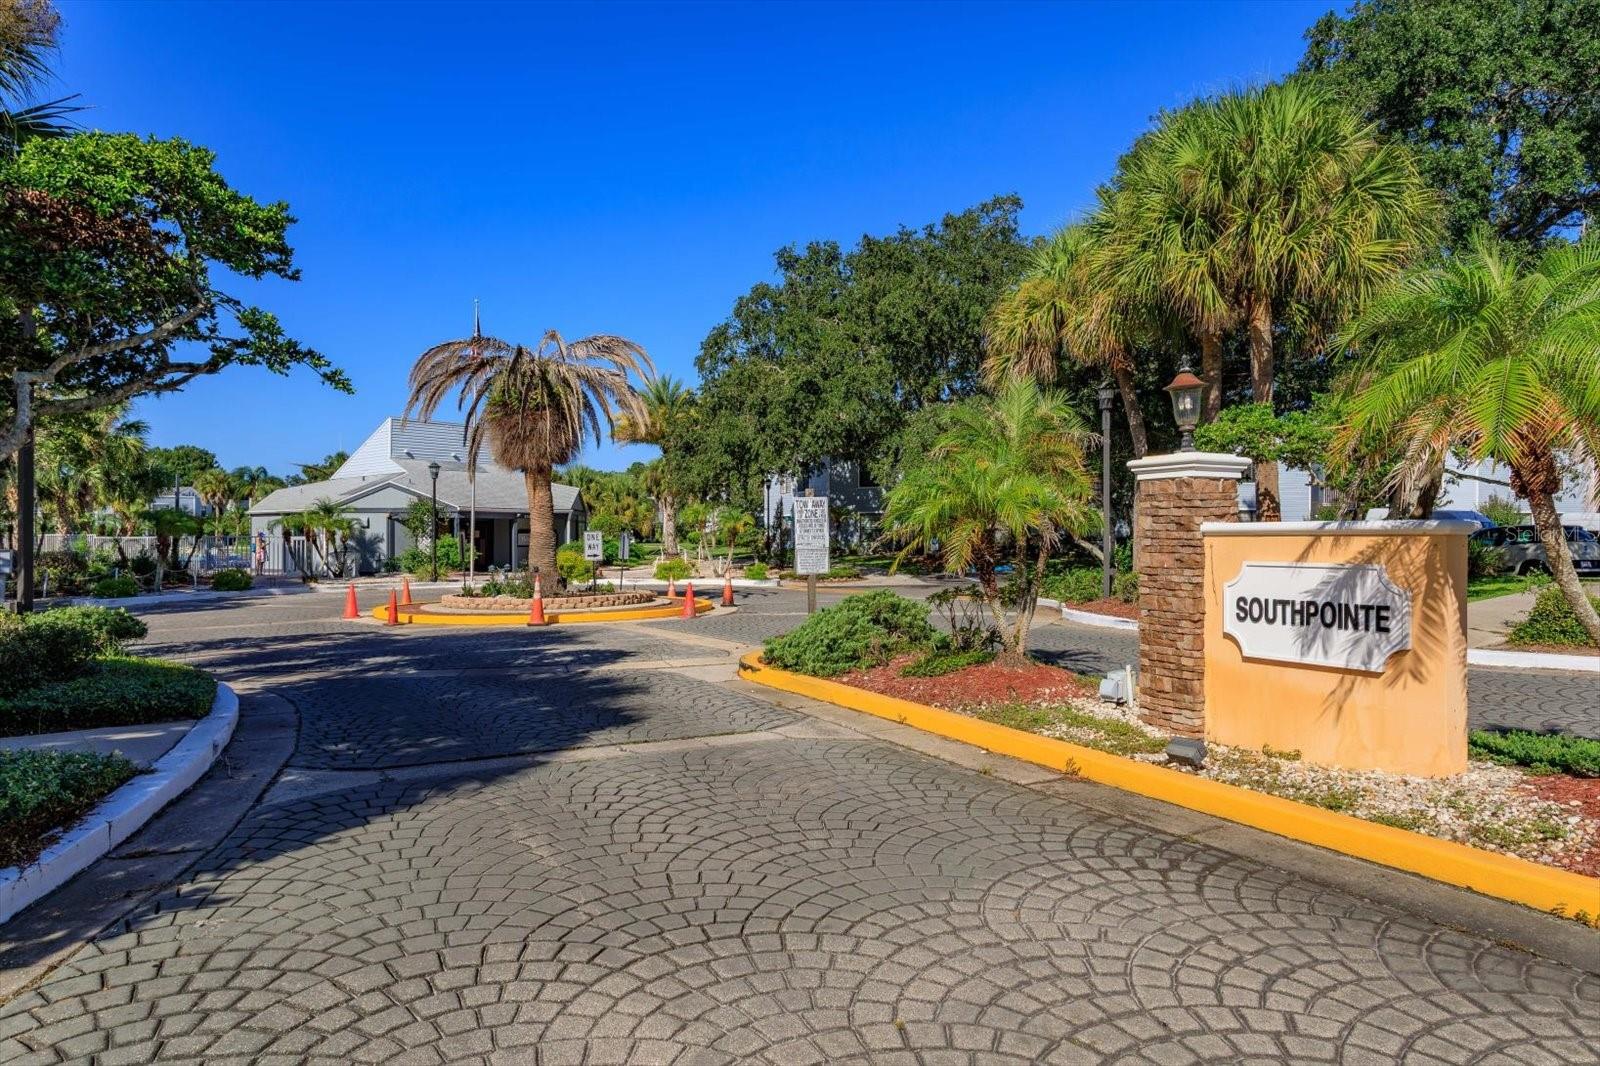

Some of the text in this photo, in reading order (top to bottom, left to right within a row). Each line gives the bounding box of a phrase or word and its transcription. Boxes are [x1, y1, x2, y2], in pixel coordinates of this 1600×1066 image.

[796, 499, 825, 508] TOW AWAY
[804, 509, 819, 519] ZONE
[587, 533, 599, 541] ONE
[1236, 596, 1391, 633] SOUTHPOINTE
